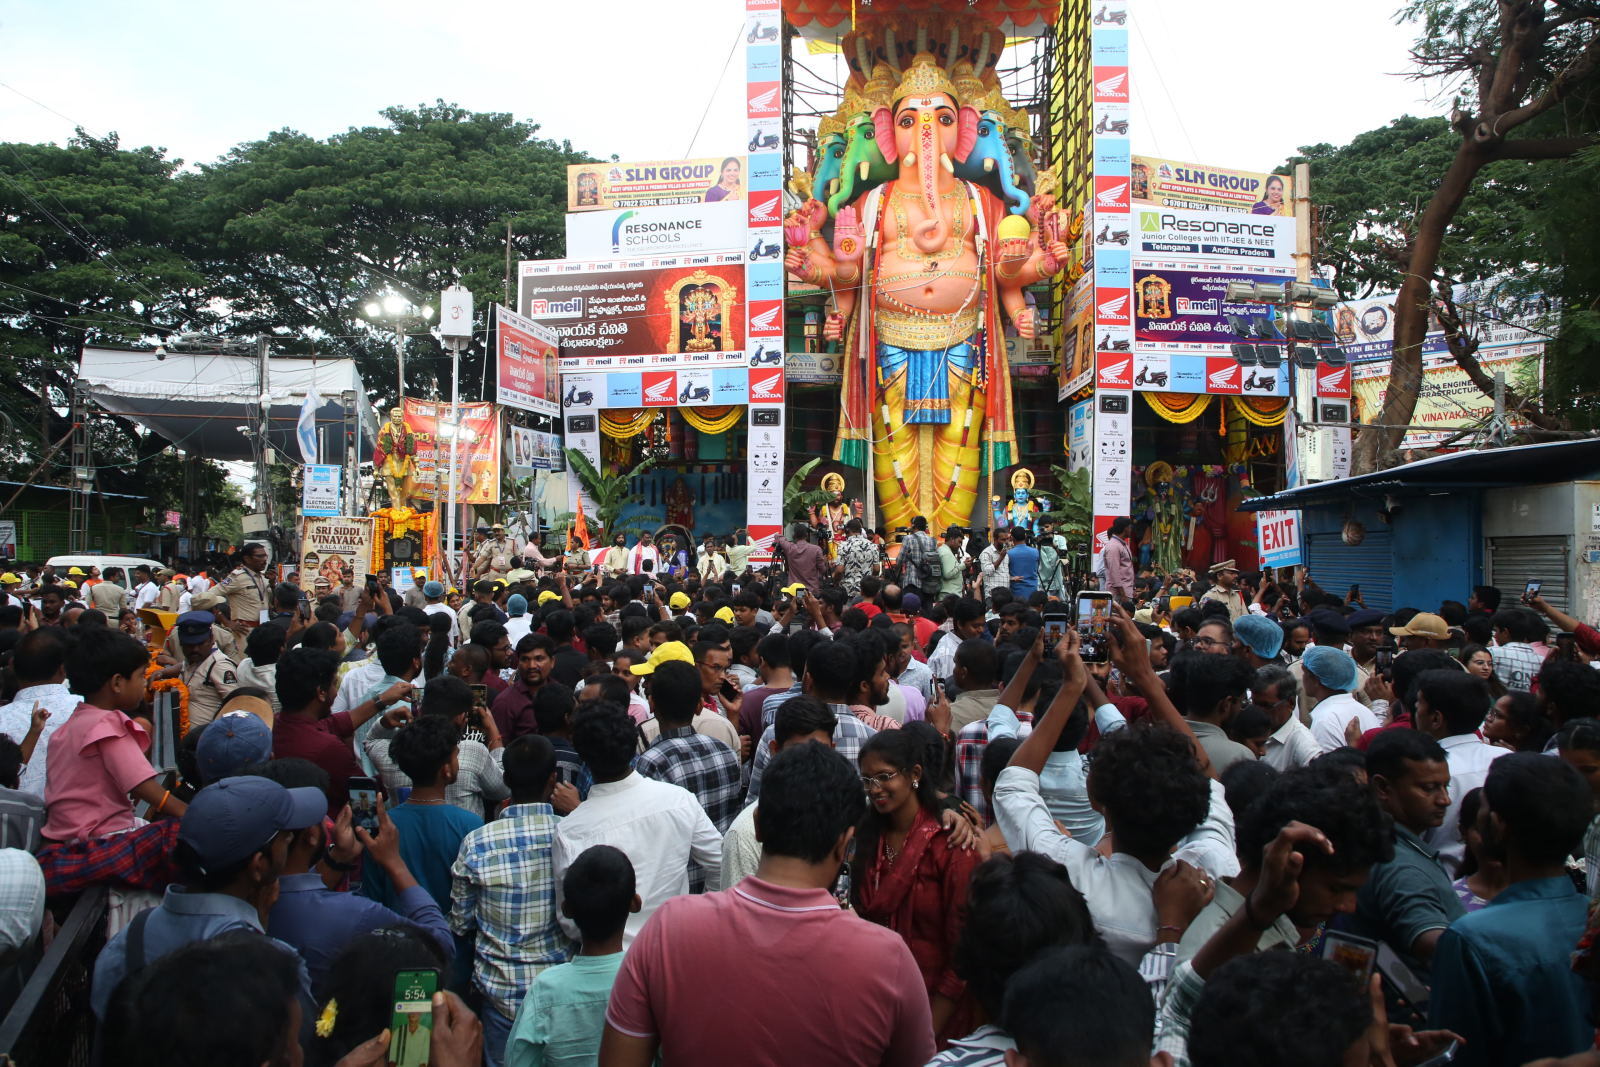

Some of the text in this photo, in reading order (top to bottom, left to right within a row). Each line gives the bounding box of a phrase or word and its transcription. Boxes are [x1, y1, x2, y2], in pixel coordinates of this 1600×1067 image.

[626, 165, 714, 181] SLN GROUP
[1175, 168, 1260, 192] SLN GROUP
[625, 220, 702, 234] RESONANCE
[1162, 215, 1275, 236] Resonance
[626, 233, 680, 245] SCHOOLS
[1168, 234, 1201, 242] Colleges
[1221, 236, 1244, 244] IIT-JEE
[1152, 244, 1190, 252] Telangana
[1212, 246, 1269, 257] Andhra Pradesh
[550, 298, 581, 313] meil
[1192, 300, 1216, 310] meil
[599, 323, 628, 334] చవితి
[1148, 321, 1187, 331] వినాయక
[1190, 322, 1211, 332] చవితి
[560, 337, 614, 348] శుభాకాంక్షలు
[1422, 410, 1468, 422] VINAYAKA
[316, 526, 360, 536] SRI SIDDI
[1263, 518, 1293, 550] EXIT
[312, 535, 364, 545] VINAYAKA
[404, 990, 426, 999] 5:54
